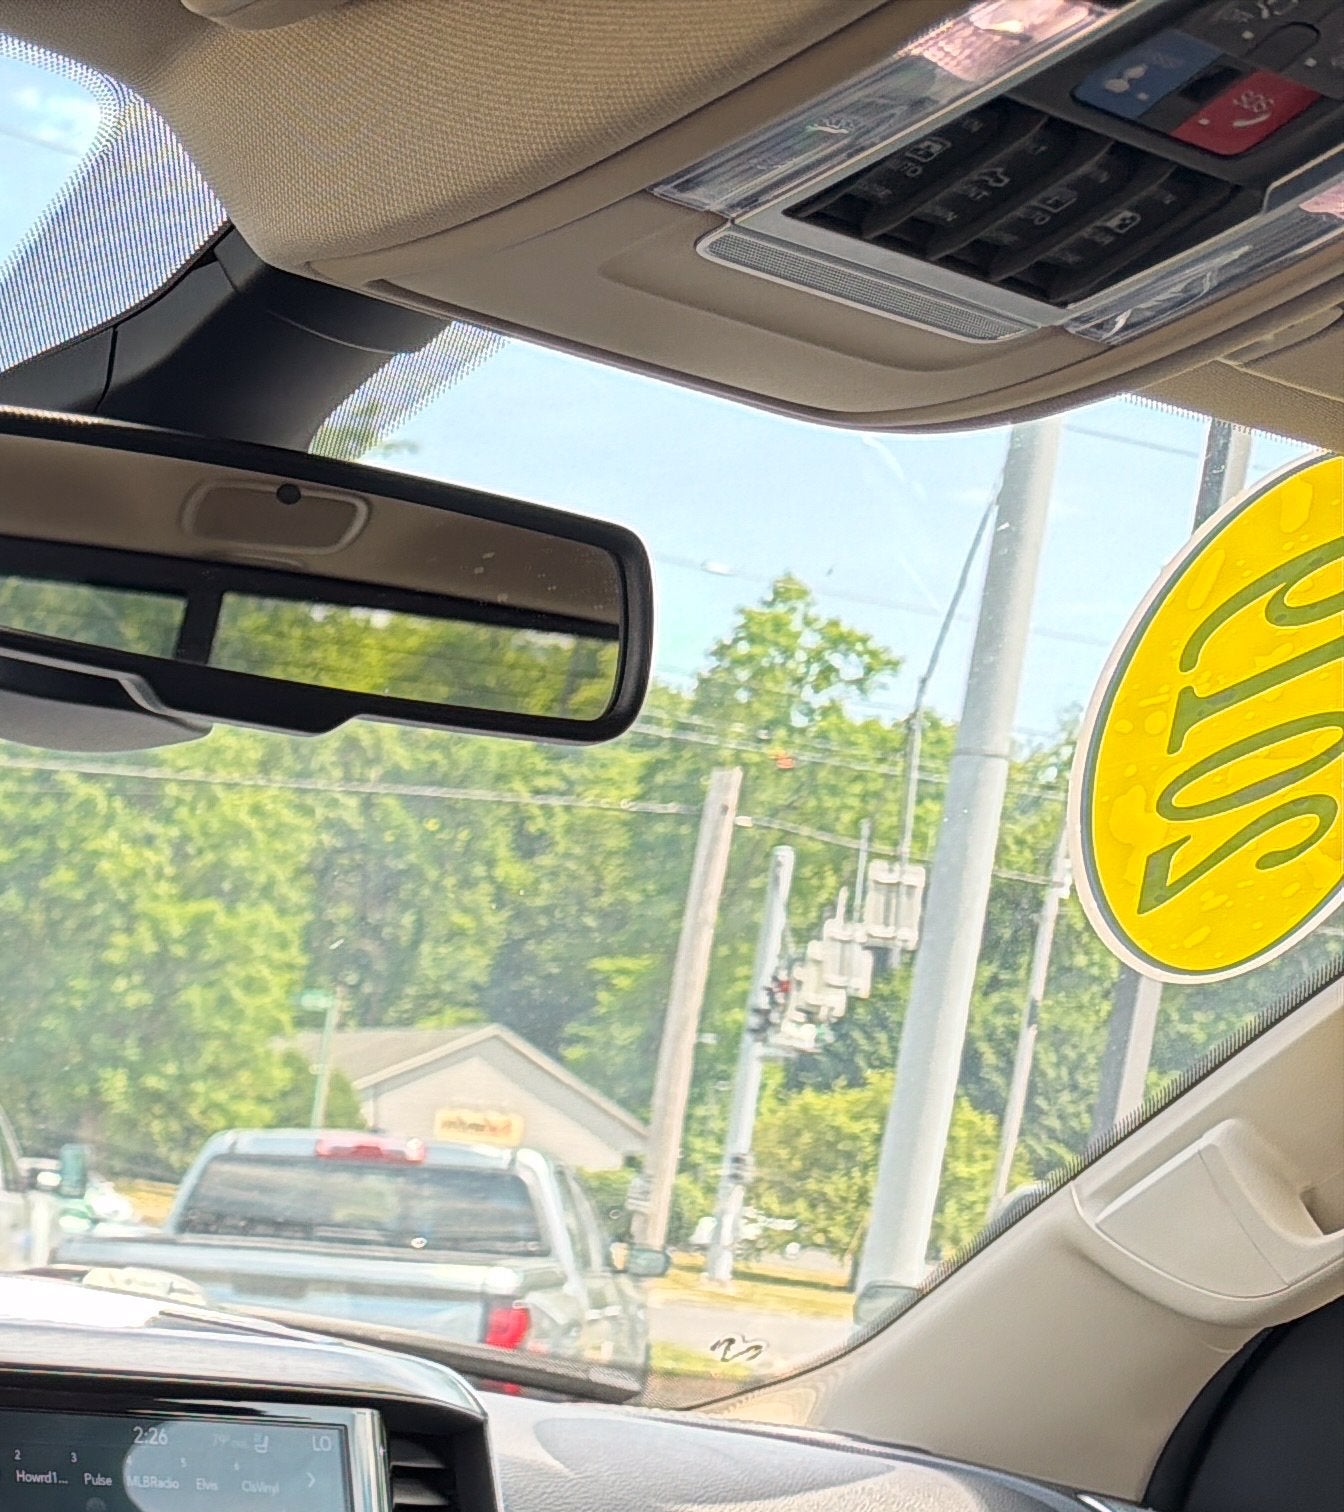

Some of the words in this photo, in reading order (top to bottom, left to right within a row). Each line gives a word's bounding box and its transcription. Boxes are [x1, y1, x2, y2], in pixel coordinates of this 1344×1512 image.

[133, 1425, 169, 1446] 2:26
[312, 1435, 332, 1452] LO
[14, 1449, 22, 1461] 2
[70, 1452, 78, 1463] 3
[84, 1472, 113, 1487] Pulse
